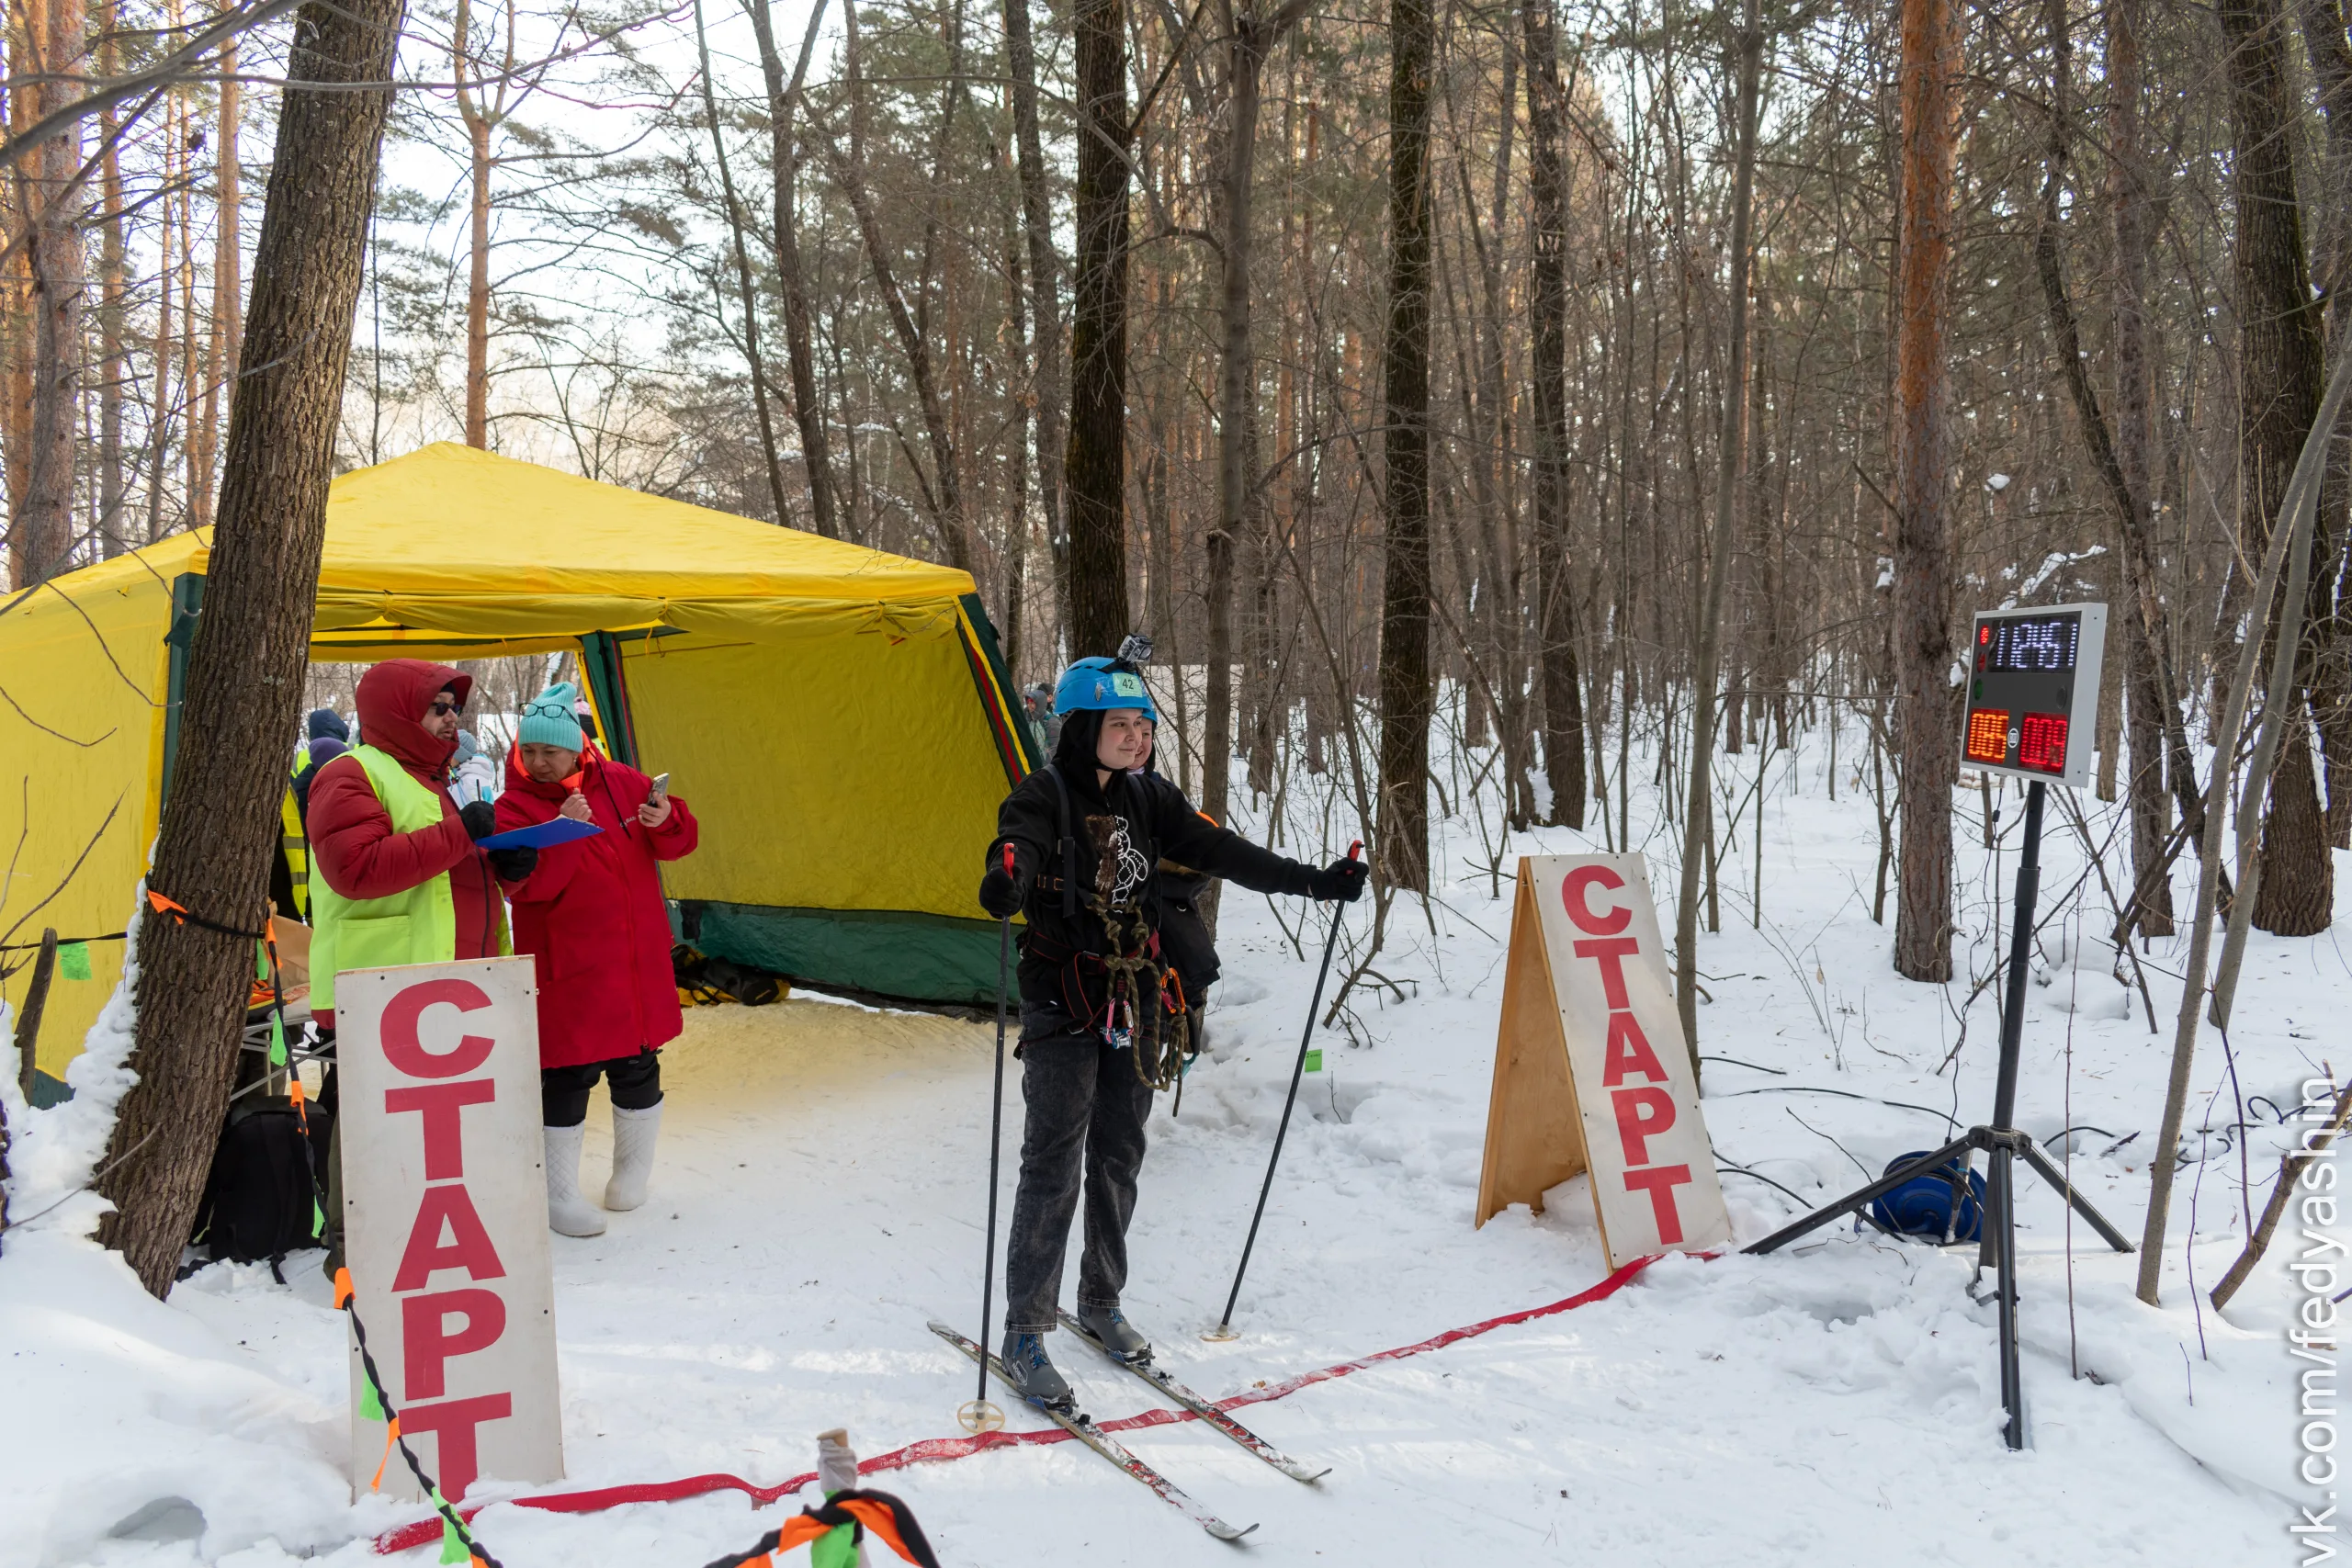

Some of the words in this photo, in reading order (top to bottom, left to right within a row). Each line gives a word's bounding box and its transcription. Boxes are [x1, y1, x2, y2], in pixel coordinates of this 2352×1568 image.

[1123, 678, 1135, 690] 42
[2020, 716, 2068, 768] 009
[1562, 865, 1692, 1246] СТАРТ
[379, 978, 512, 1505] СТАРТ
